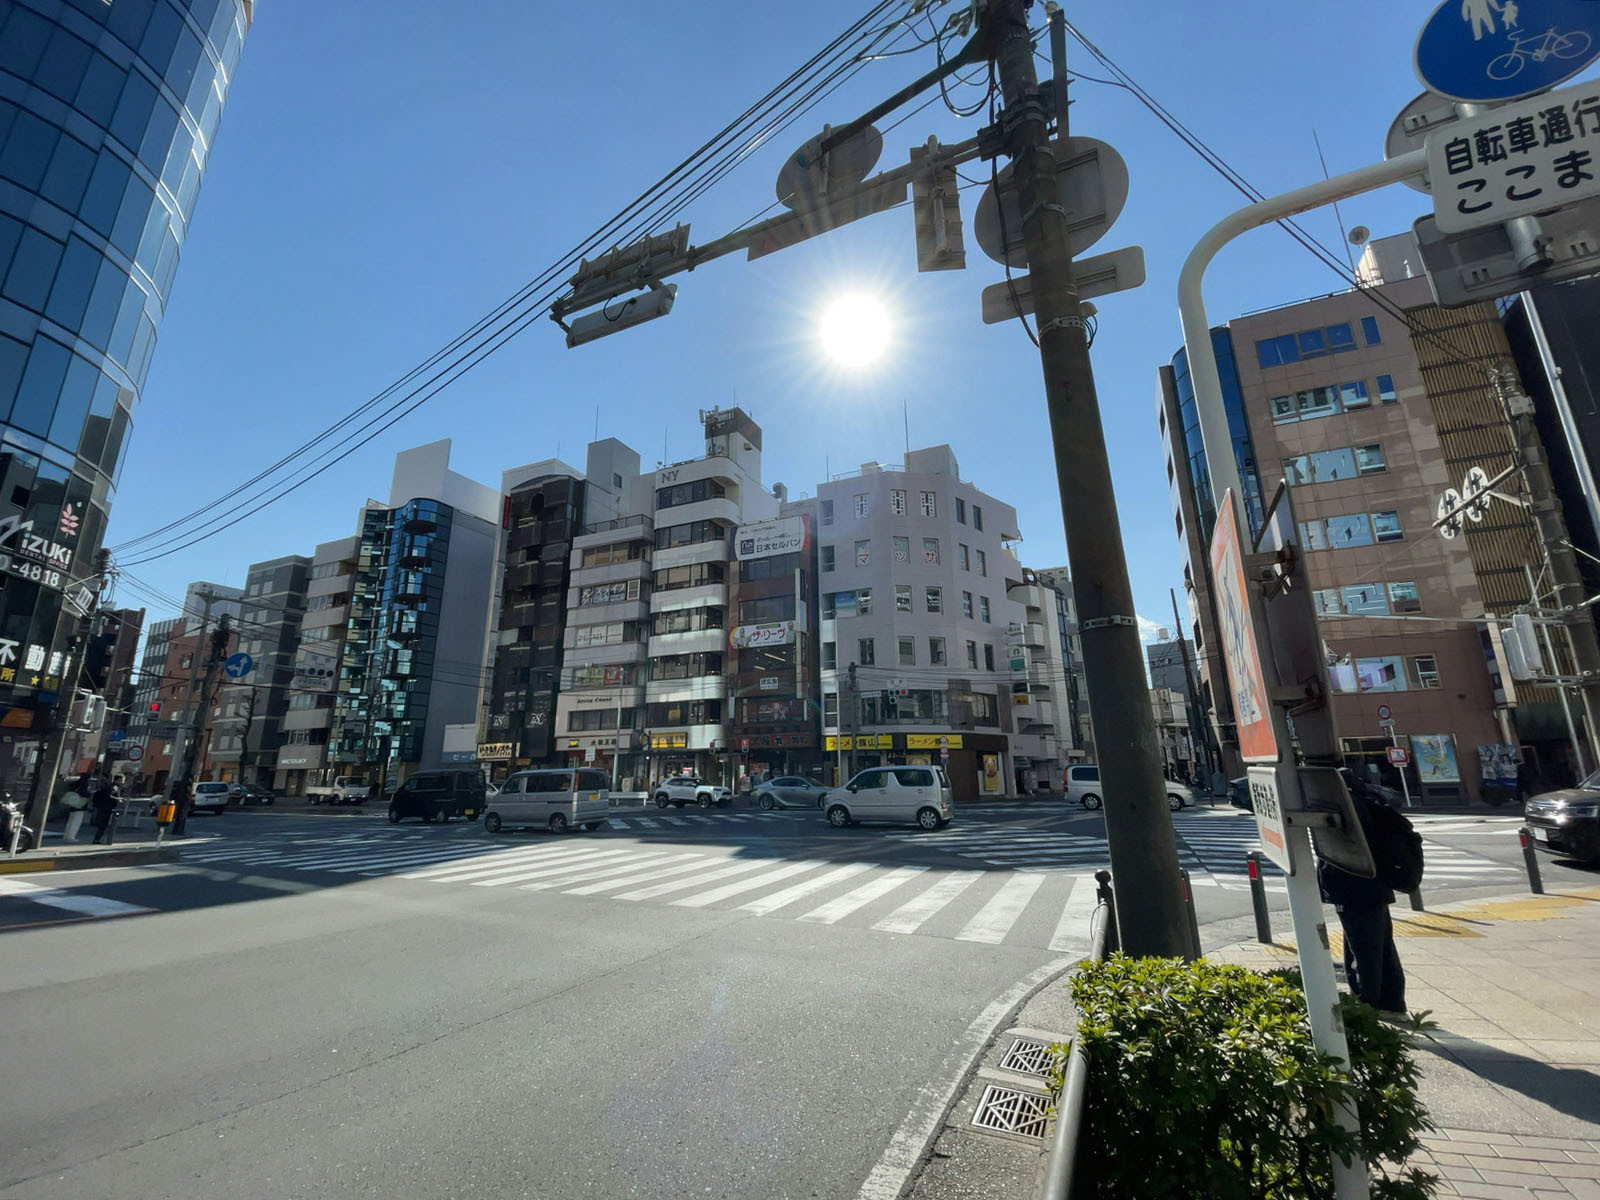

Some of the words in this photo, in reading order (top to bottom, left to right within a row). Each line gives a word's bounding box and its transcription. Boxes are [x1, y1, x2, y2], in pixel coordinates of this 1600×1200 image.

[1445, 96, 1600, 175] 自転車通行
[662, 470, 680, 483] NY
[20, 549, 46, 561] DENTAL
[49, 558, 68, 570] OFFICE
